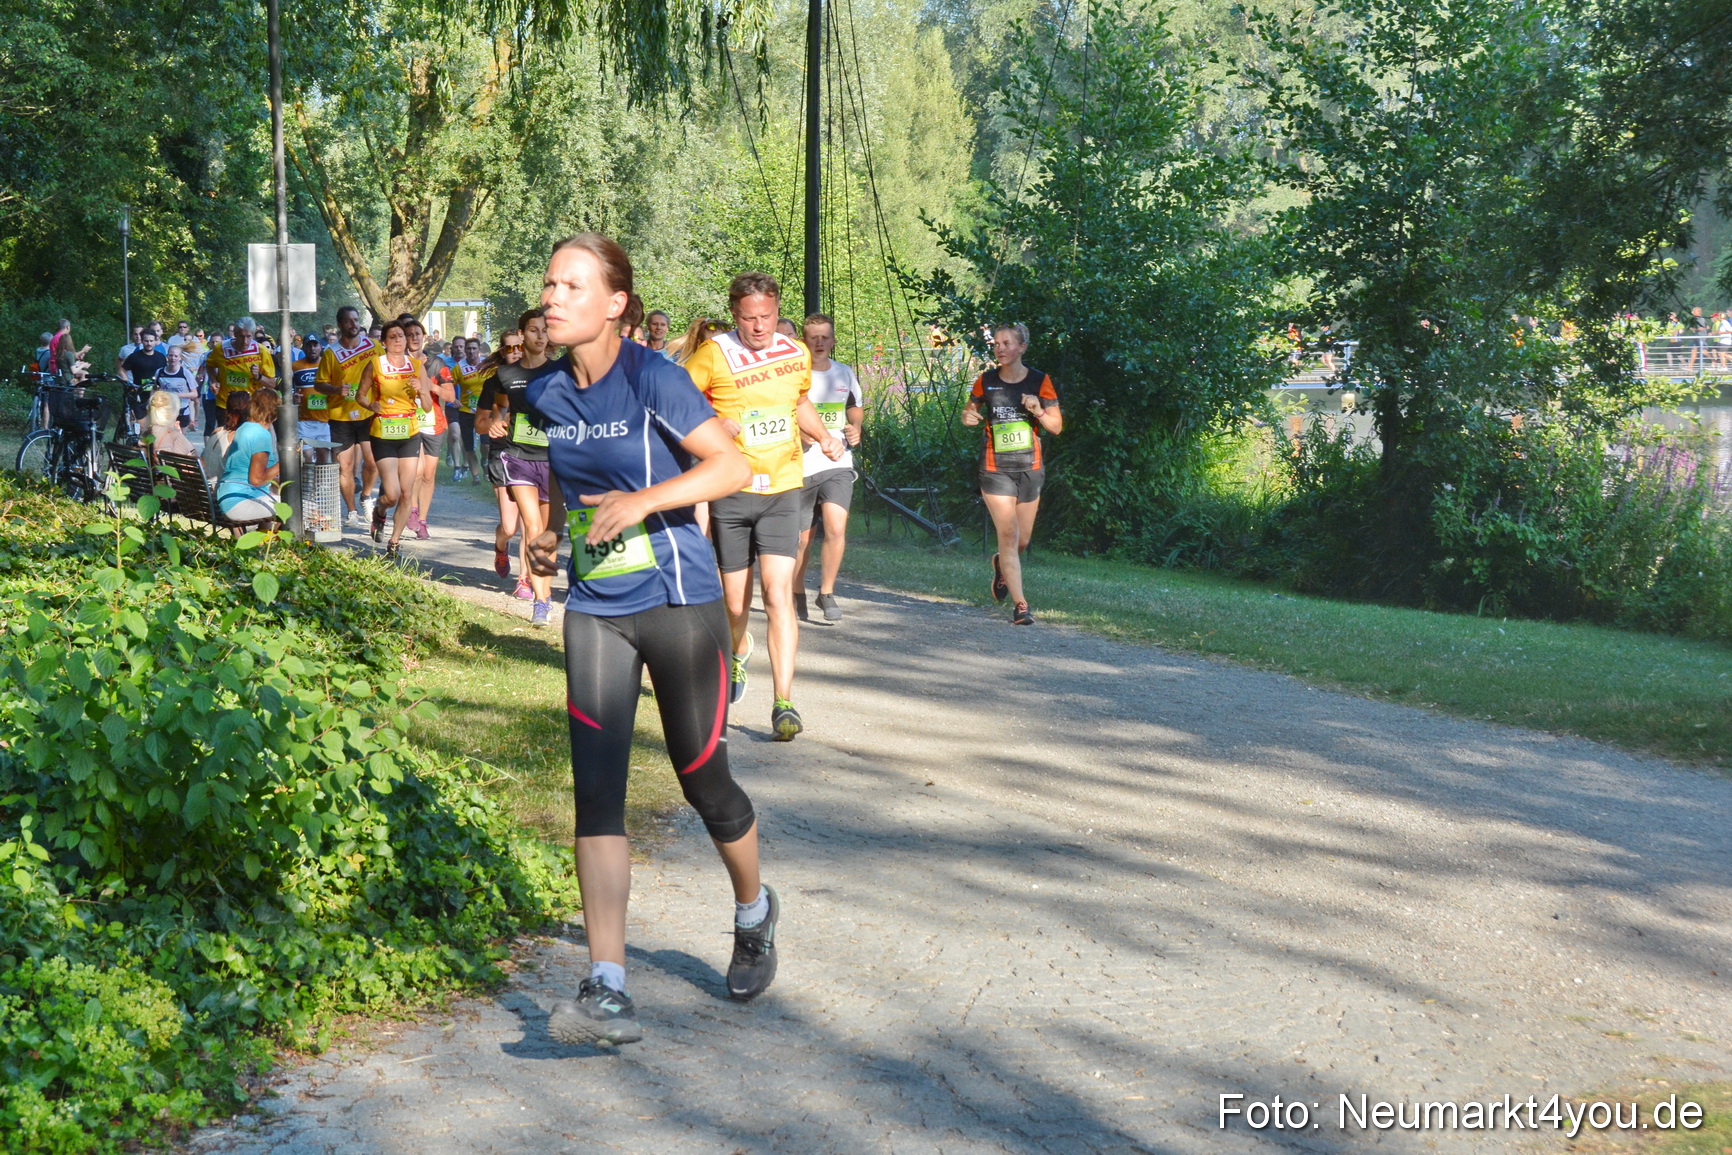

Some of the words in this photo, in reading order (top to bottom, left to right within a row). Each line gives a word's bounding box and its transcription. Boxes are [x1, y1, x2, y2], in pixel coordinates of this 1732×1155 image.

[734, 370, 772, 389] MAX
[774, 361, 807, 377] BÖGL
[384, 425, 406, 434] 1318
[749, 418, 787, 437] 1322
[1002, 432, 1022, 444] 801
[585, 532, 626, 558] 498
